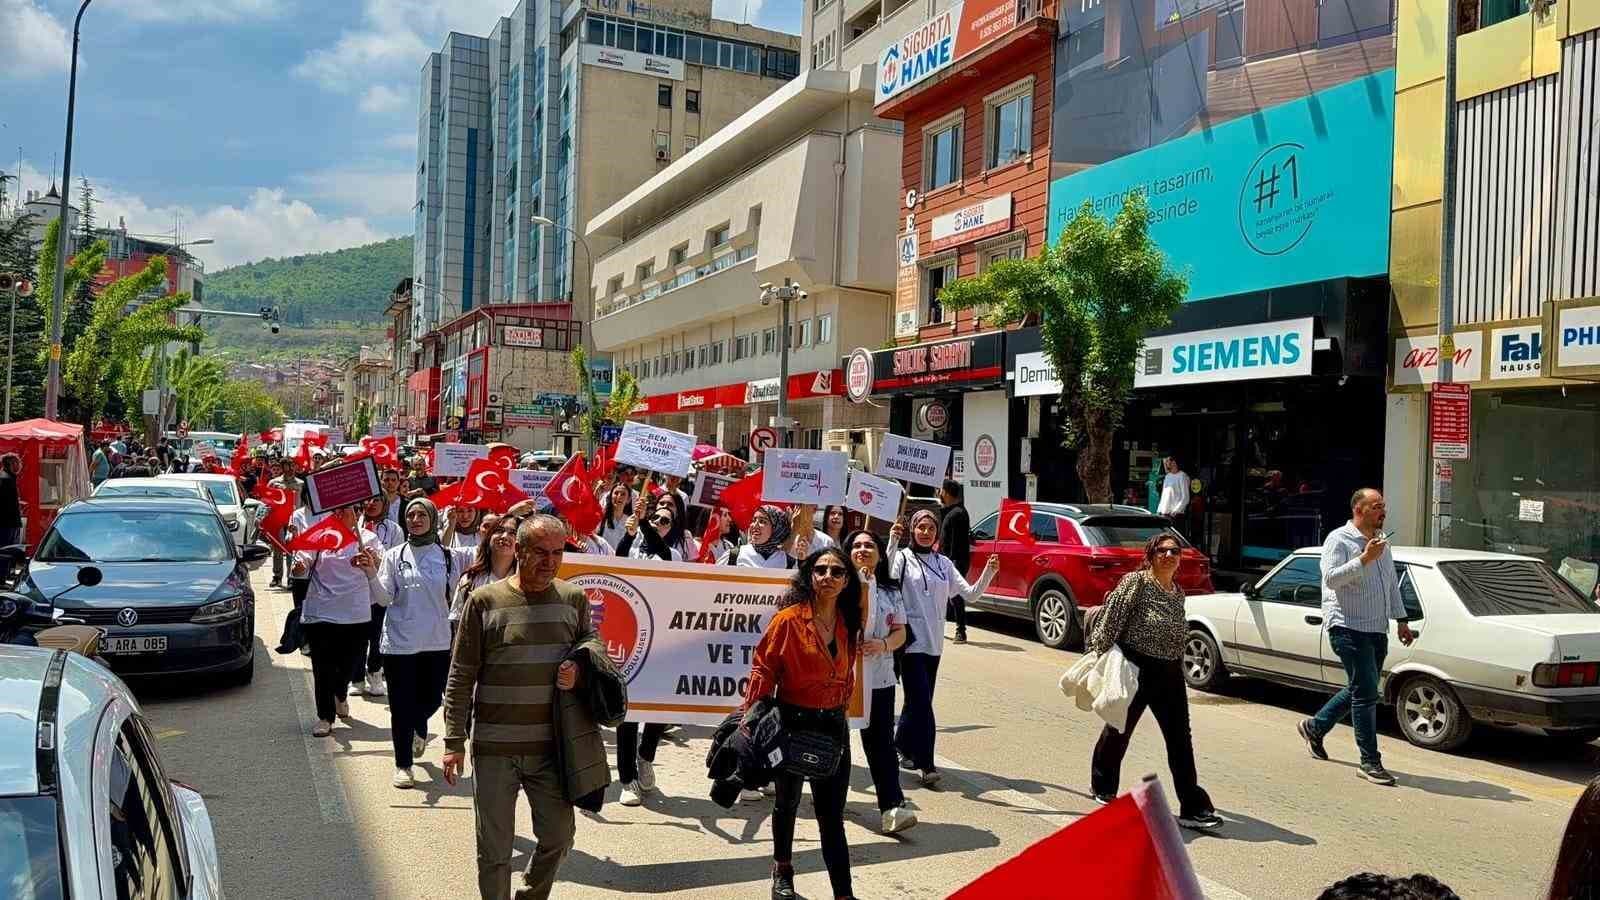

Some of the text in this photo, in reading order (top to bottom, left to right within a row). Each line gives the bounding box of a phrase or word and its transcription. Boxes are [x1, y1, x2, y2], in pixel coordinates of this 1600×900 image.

[901, 36, 951, 86] HANE
[1253, 154, 1299, 213] #1
[962, 214, 984, 229] HANE
[1172, 332, 1300, 374] SIEMENS
[1403, 347, 1472, 368] arzm
[648, 433, 668, 442] BEN
[640, 445, 670, 457] VARIM
[668, 608, 762, 633] ATATÜRK
[115, 639, 137, 650] ARA
[143, 638, 165, 650] 085
[707, 643, 757, 664] VE T
